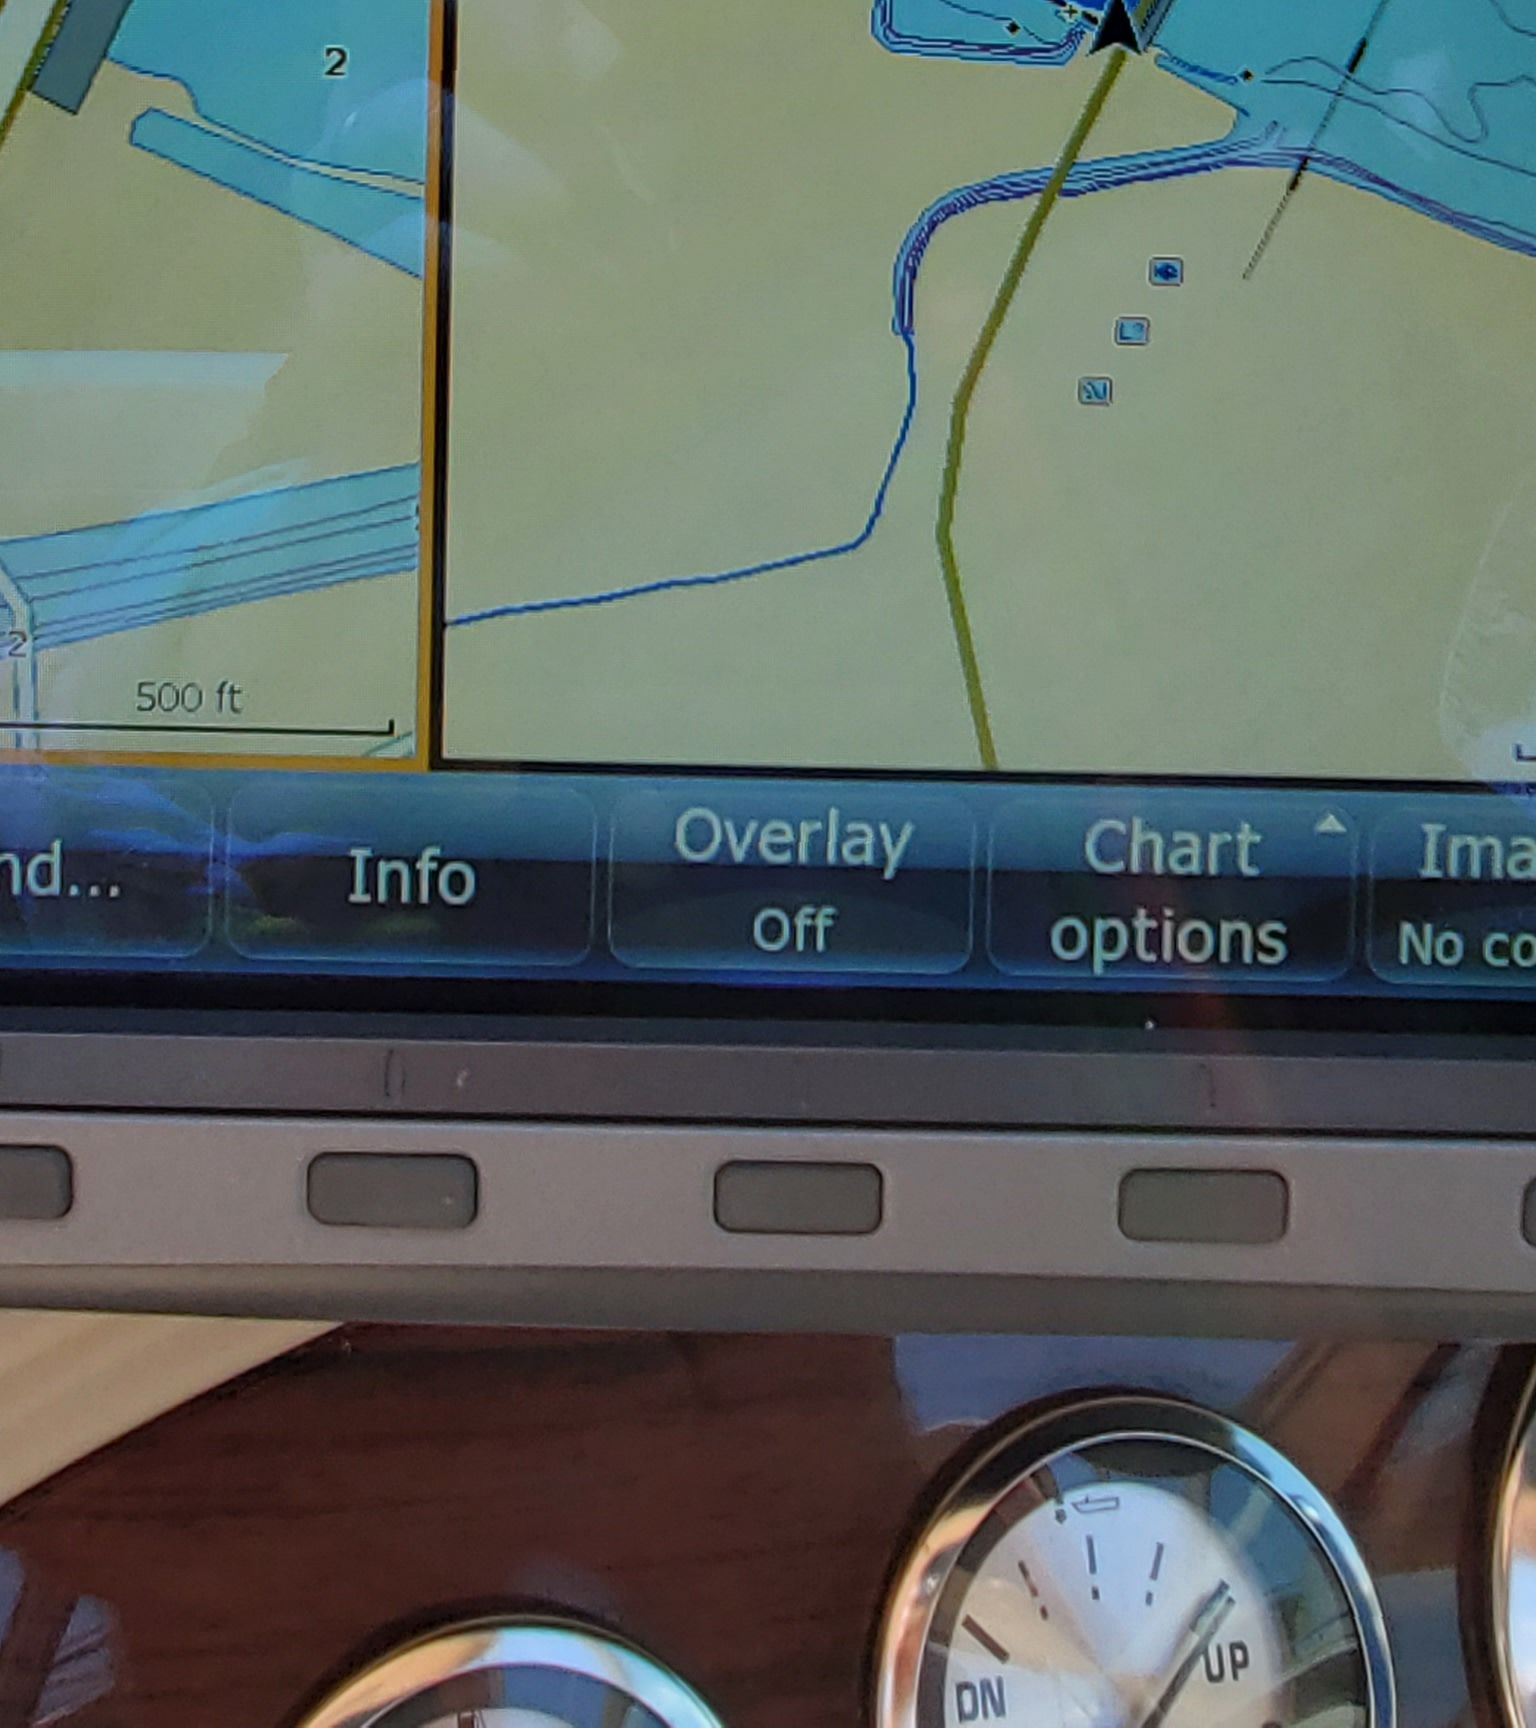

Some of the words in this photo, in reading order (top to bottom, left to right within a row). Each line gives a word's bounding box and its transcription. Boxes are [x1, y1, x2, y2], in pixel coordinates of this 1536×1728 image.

[322, 46, 348, 78] 2
[136, 680, 204, 713] 500
[215, 679, 243, 714] ft
[674, 809, 912, 879] Overlay
[1084, 819, 1262, 878] Chart
[348, 846, 476, 906] Info
[751, 906, 837, 954] Off
[1048, 902, 1288, 970] options
[1398, 921, 1463, 967] No
[1204, 1640, 1250, 1684] UP
[954, 1675, 1006, 1724] DN
